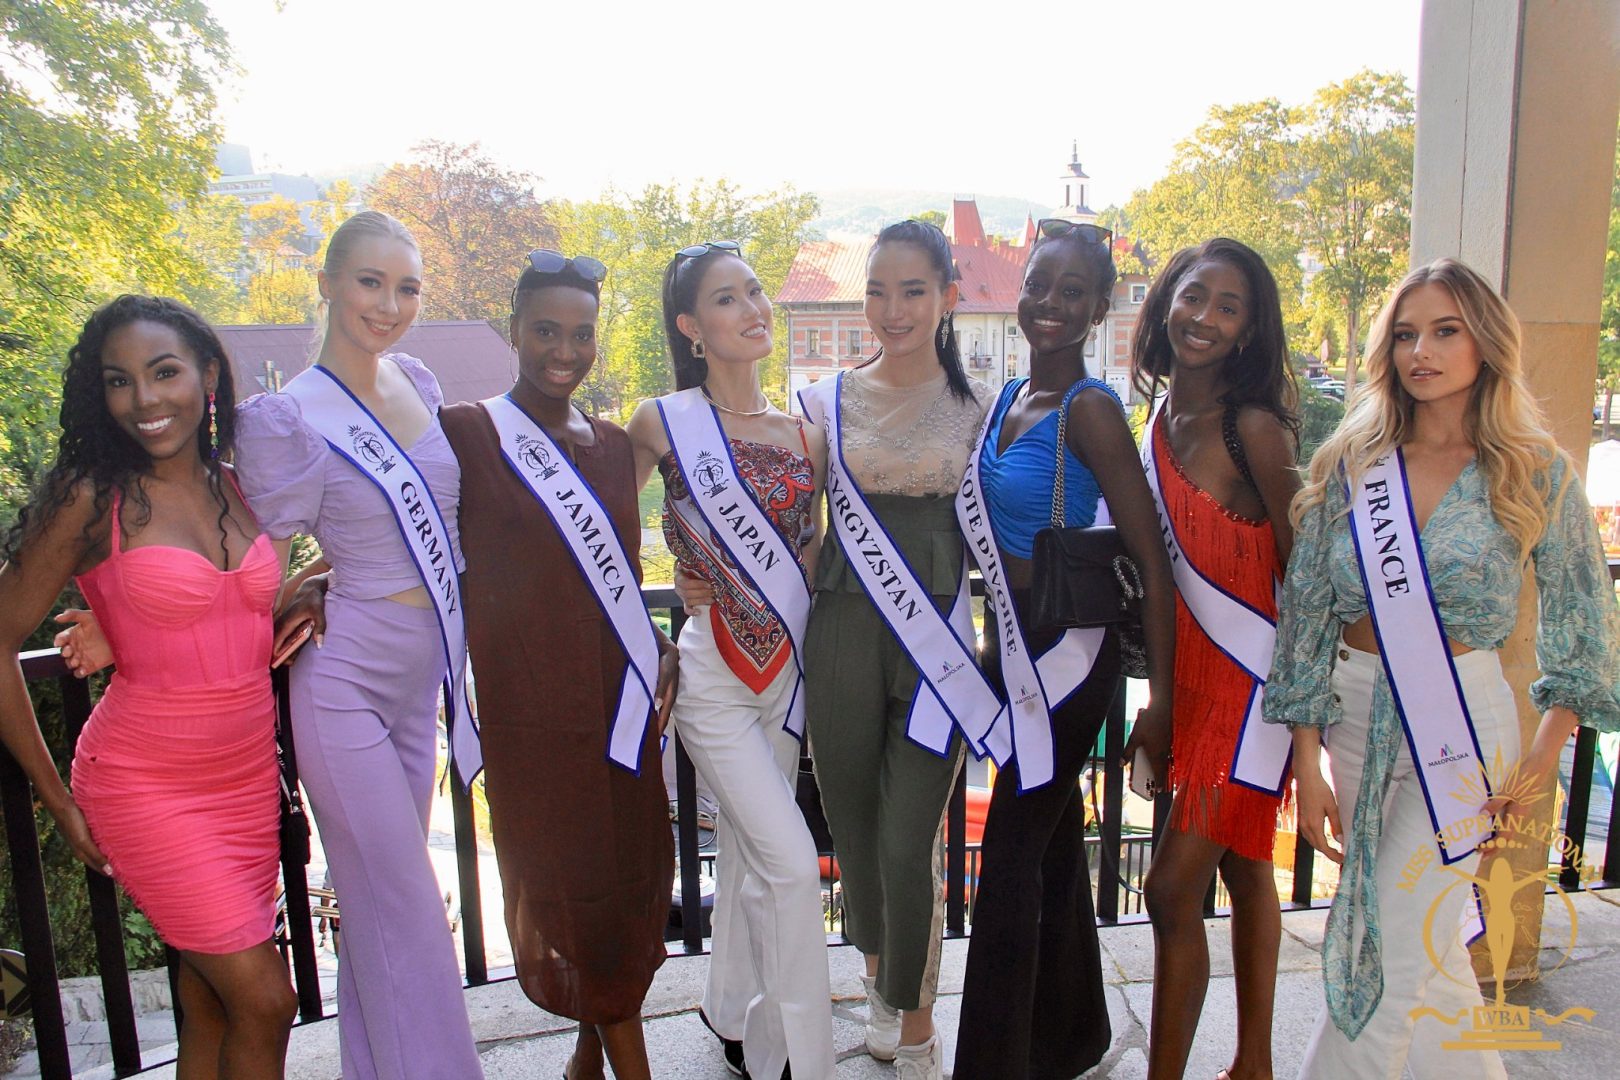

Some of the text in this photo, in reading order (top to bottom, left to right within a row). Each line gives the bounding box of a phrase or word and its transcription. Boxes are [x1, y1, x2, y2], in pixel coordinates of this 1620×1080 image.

[401, 481, 457, 616] GERMANY
[555, 488, 626, 604] JAMAICA
[719, 501, 780, 572] JAPAN
[829, 462, 922, 621] KYRGYZSTAN
[976, 536, 1017, 656] D'IVOIRE
[1364, 478, 1410, 598] FRANCE
